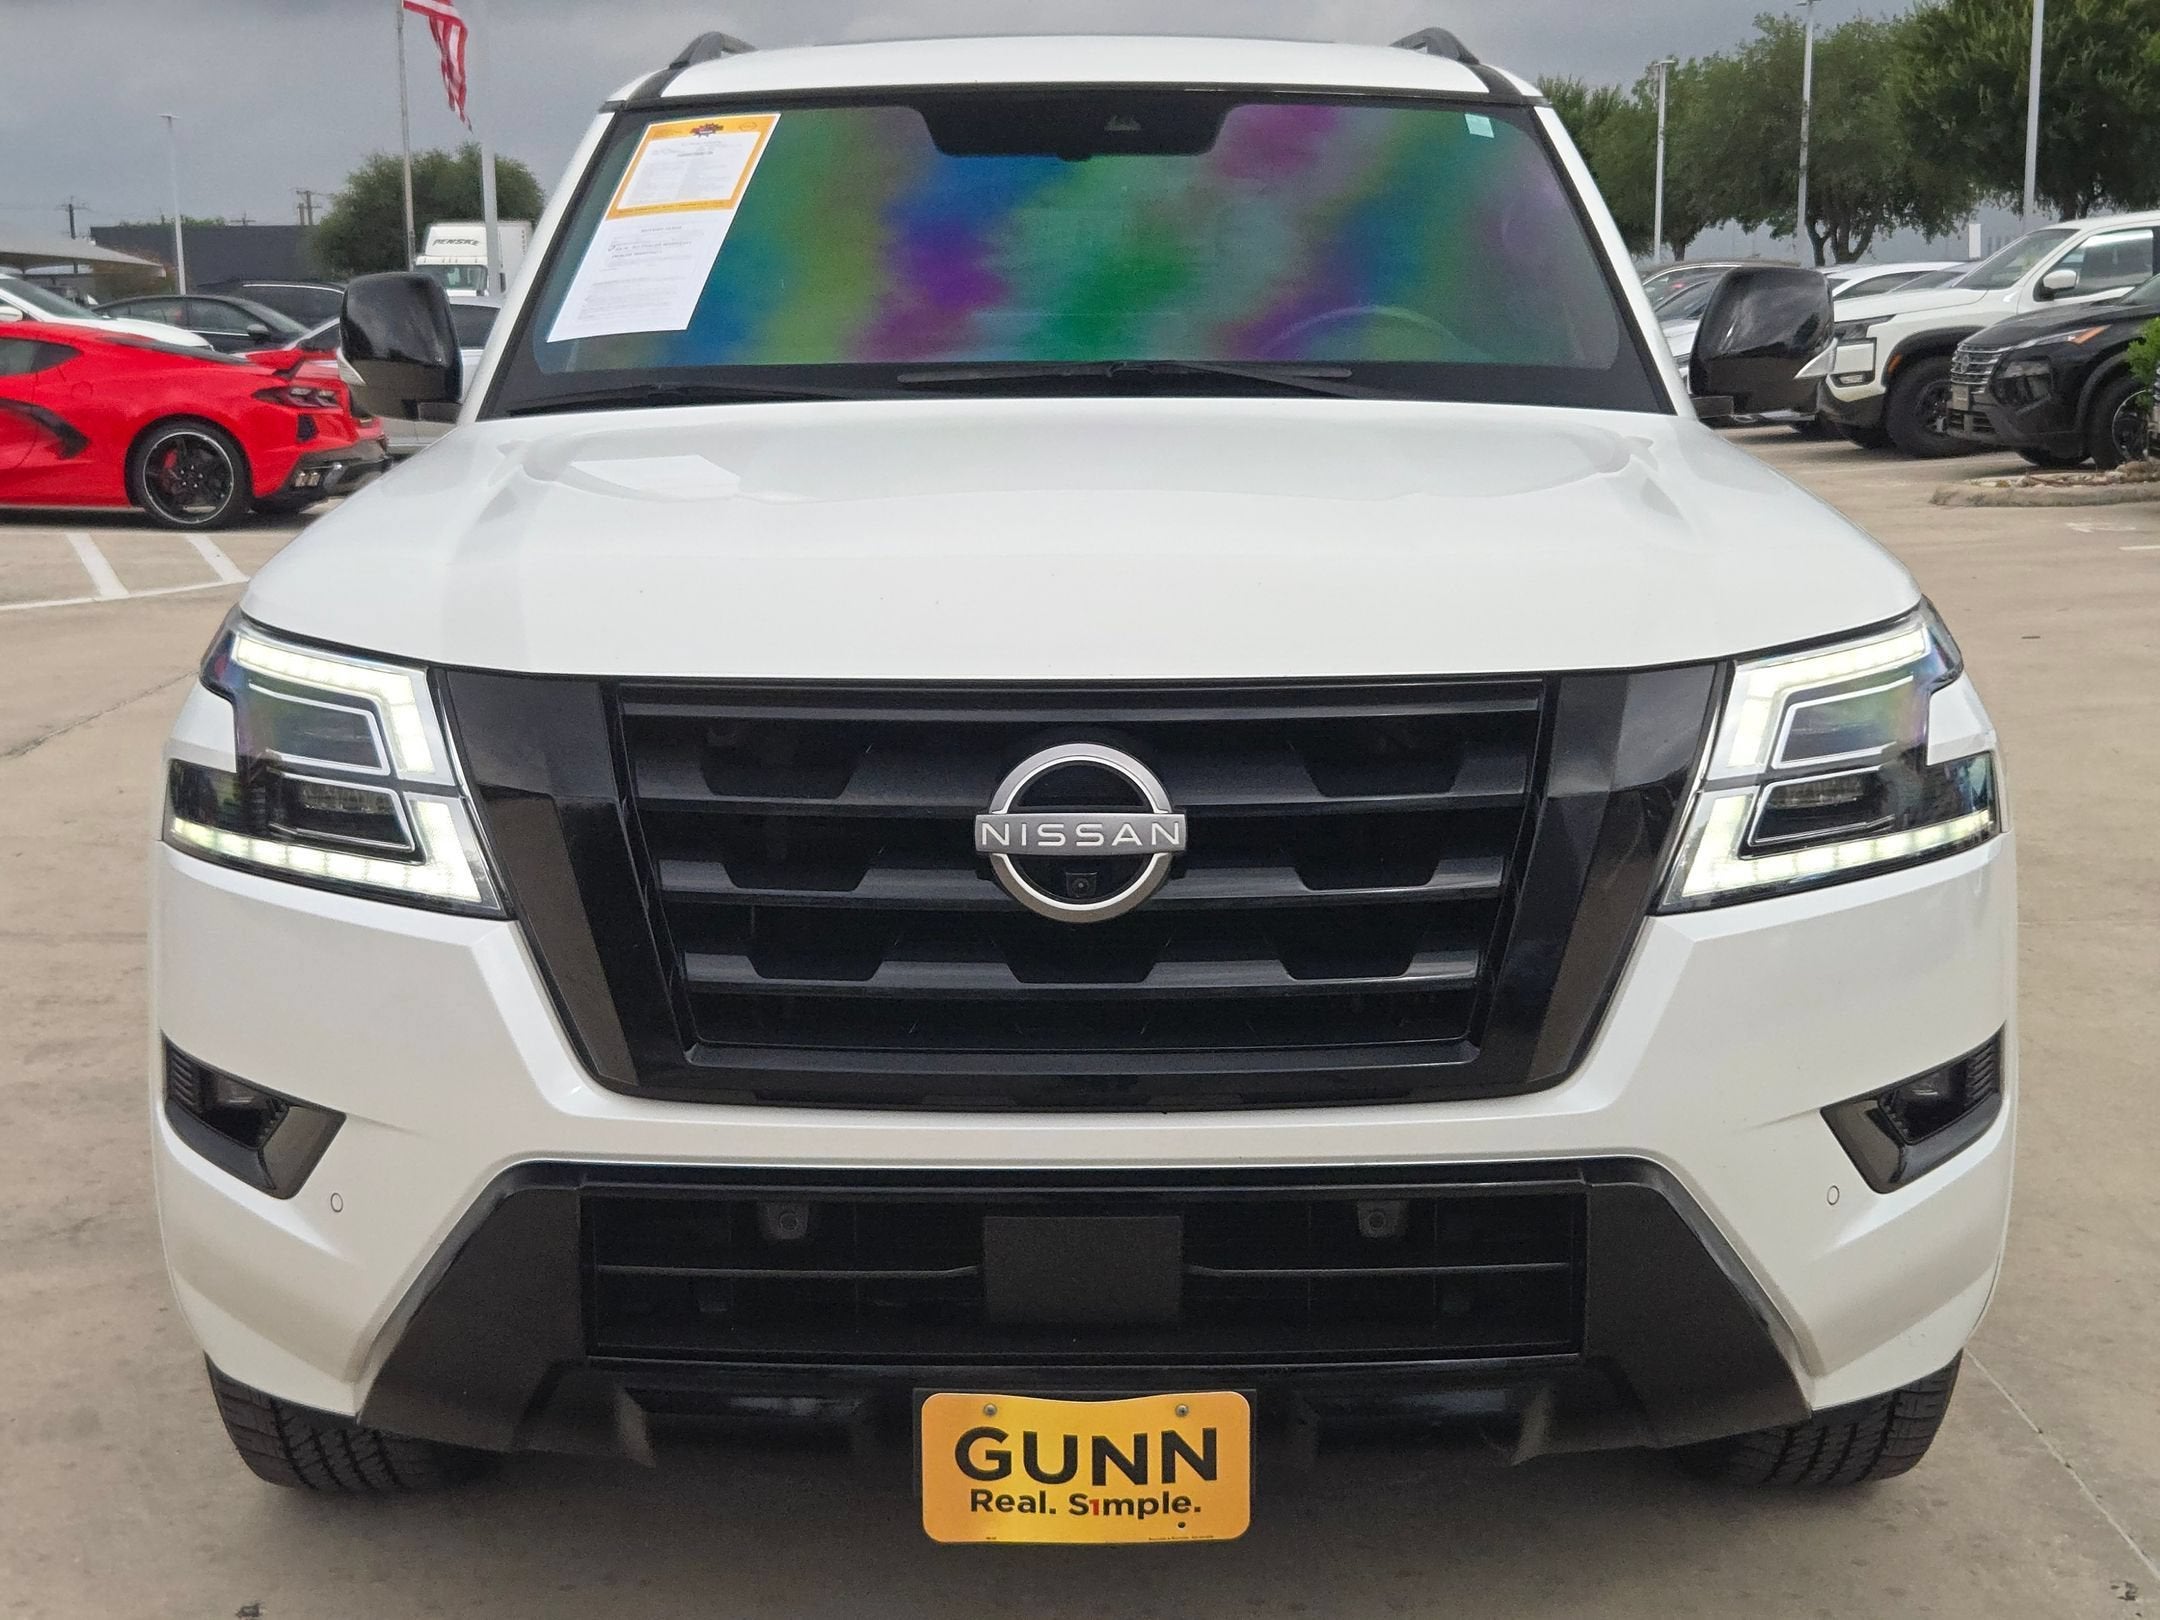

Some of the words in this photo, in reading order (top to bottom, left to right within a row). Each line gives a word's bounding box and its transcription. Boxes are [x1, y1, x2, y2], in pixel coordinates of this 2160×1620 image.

[432, 238, 480, 247] PENSKE
[981, 822, 1180, 847] NISSAN
[954, 1426, 1218, 1486] GUNN
[970, 1488, 1057, 1515] Real.
